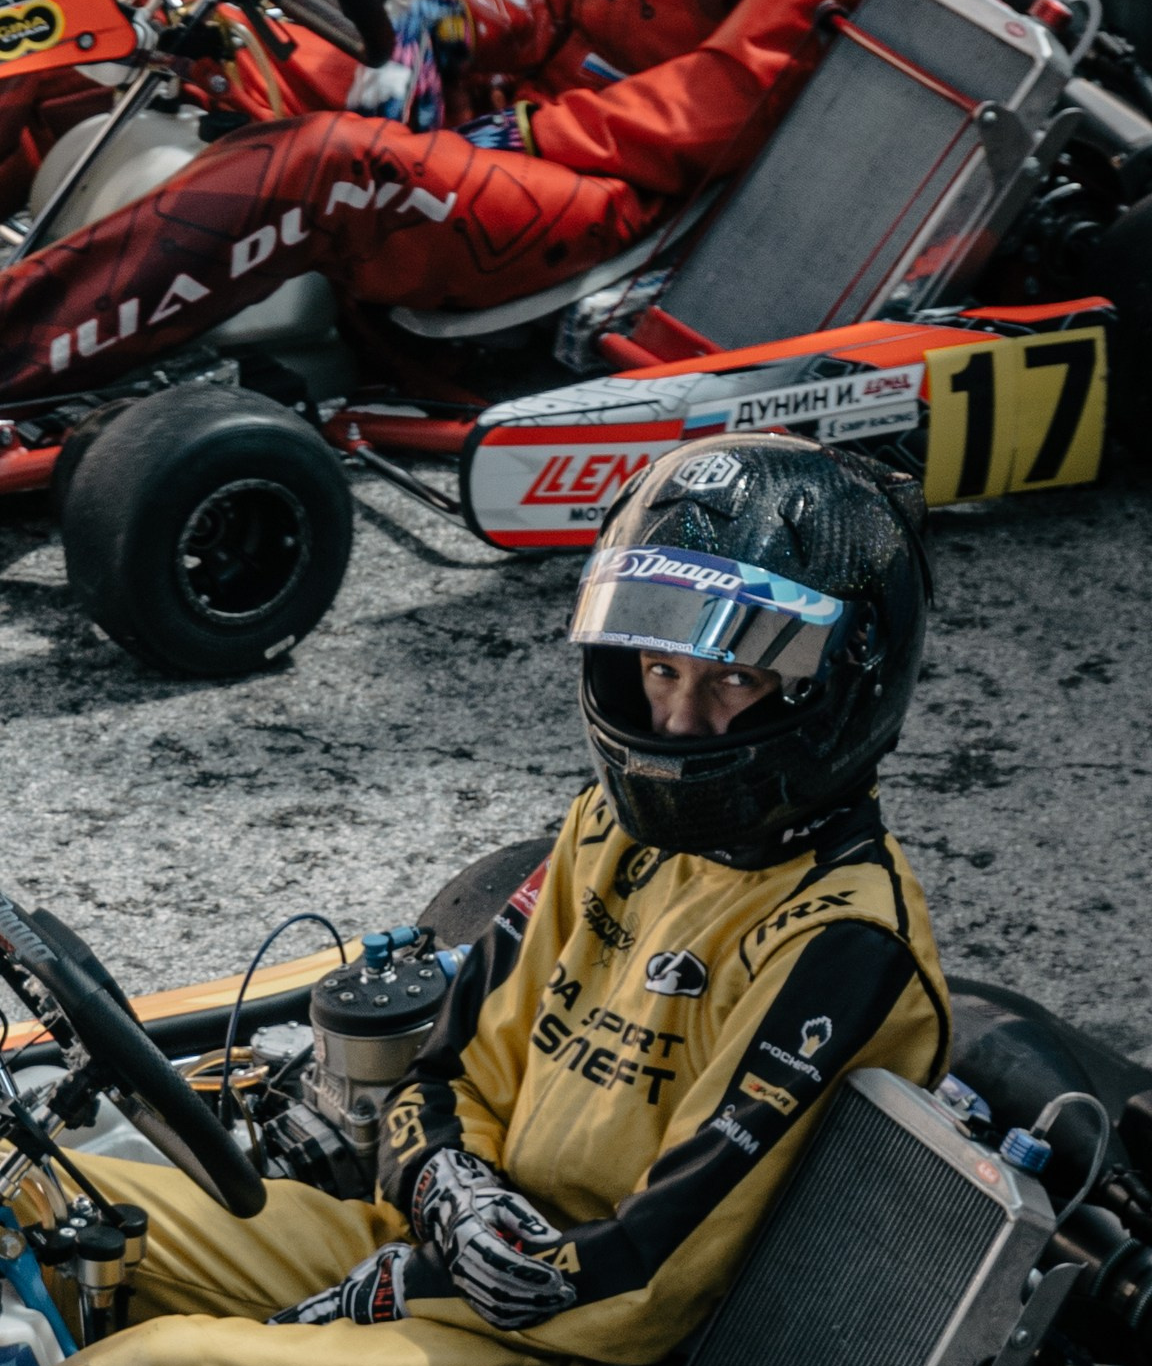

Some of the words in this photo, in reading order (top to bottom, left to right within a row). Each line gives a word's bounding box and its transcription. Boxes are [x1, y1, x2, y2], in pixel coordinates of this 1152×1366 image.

[49, 272, 212, 375] ILIA
[734, 386, 829, 429] ДУНИН
[949, 337, 1097, 501] 17
[531, 1012, 676, 1106] SNEFT
